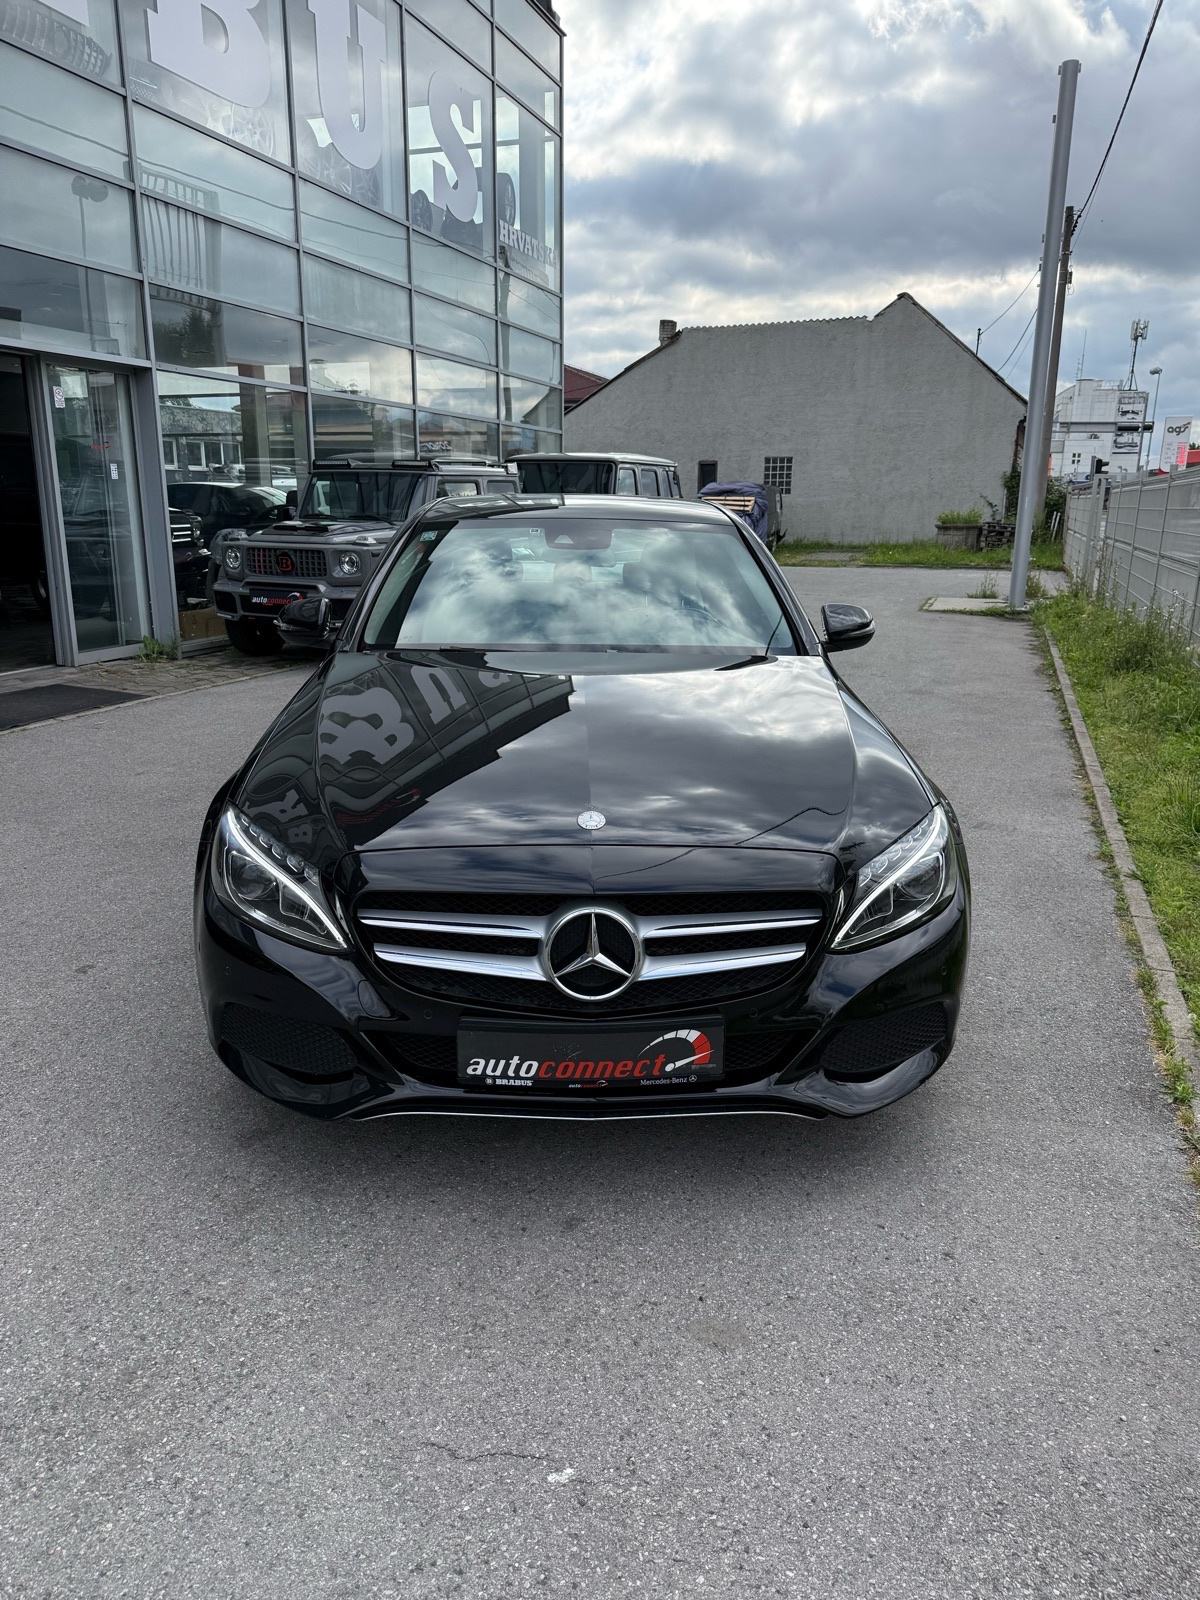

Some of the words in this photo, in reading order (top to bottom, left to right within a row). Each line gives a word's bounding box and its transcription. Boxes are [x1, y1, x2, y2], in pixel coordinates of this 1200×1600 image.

[37, 0, 479, 223] BUS
[467, 1055, 666, 1077] autoconnect
[495, 1078, 533, 1086] BRABUS
